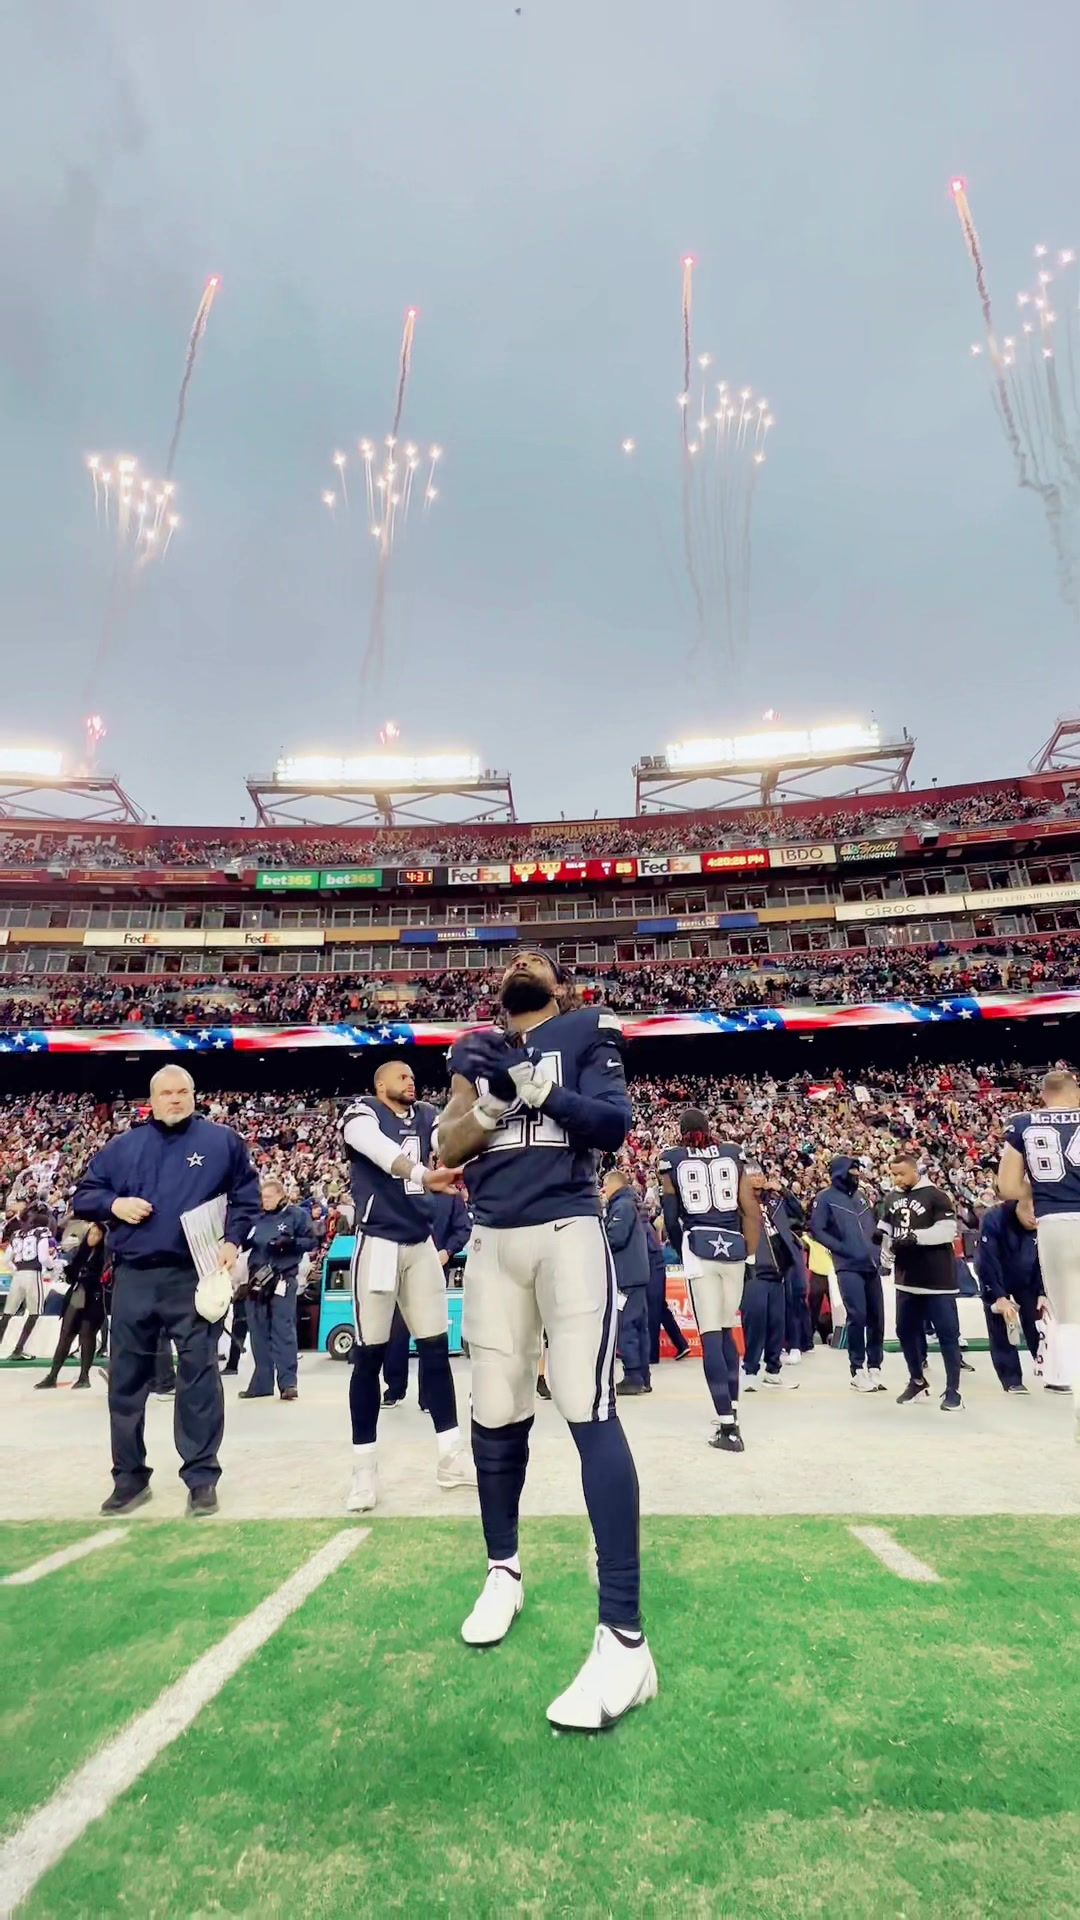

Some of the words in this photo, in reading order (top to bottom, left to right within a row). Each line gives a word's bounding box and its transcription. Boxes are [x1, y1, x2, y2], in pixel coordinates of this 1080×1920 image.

[748, 854, 765, 865] PM
[785, 847, 824, 861] BDO
[843, 850, 897, 862] WASHINGTON
[641, 857, 692, 874] FedEx
[262, 874, 312, 885] bet365
[326, 873, 375, 885] bet365
[452, 868, 501, 883] FedEx
[124, 933, 160, 944] FedEx
[245, 933, 280, 944] FedEx
[687, 1145, 720, 1158] LAMB
[677, 1157, 739, 1214] 88
[889, 1198, 909, 1214] LOVE
[909, 1199, 926, 1216] FOR
[901, 1208, 910, 1227] 3
